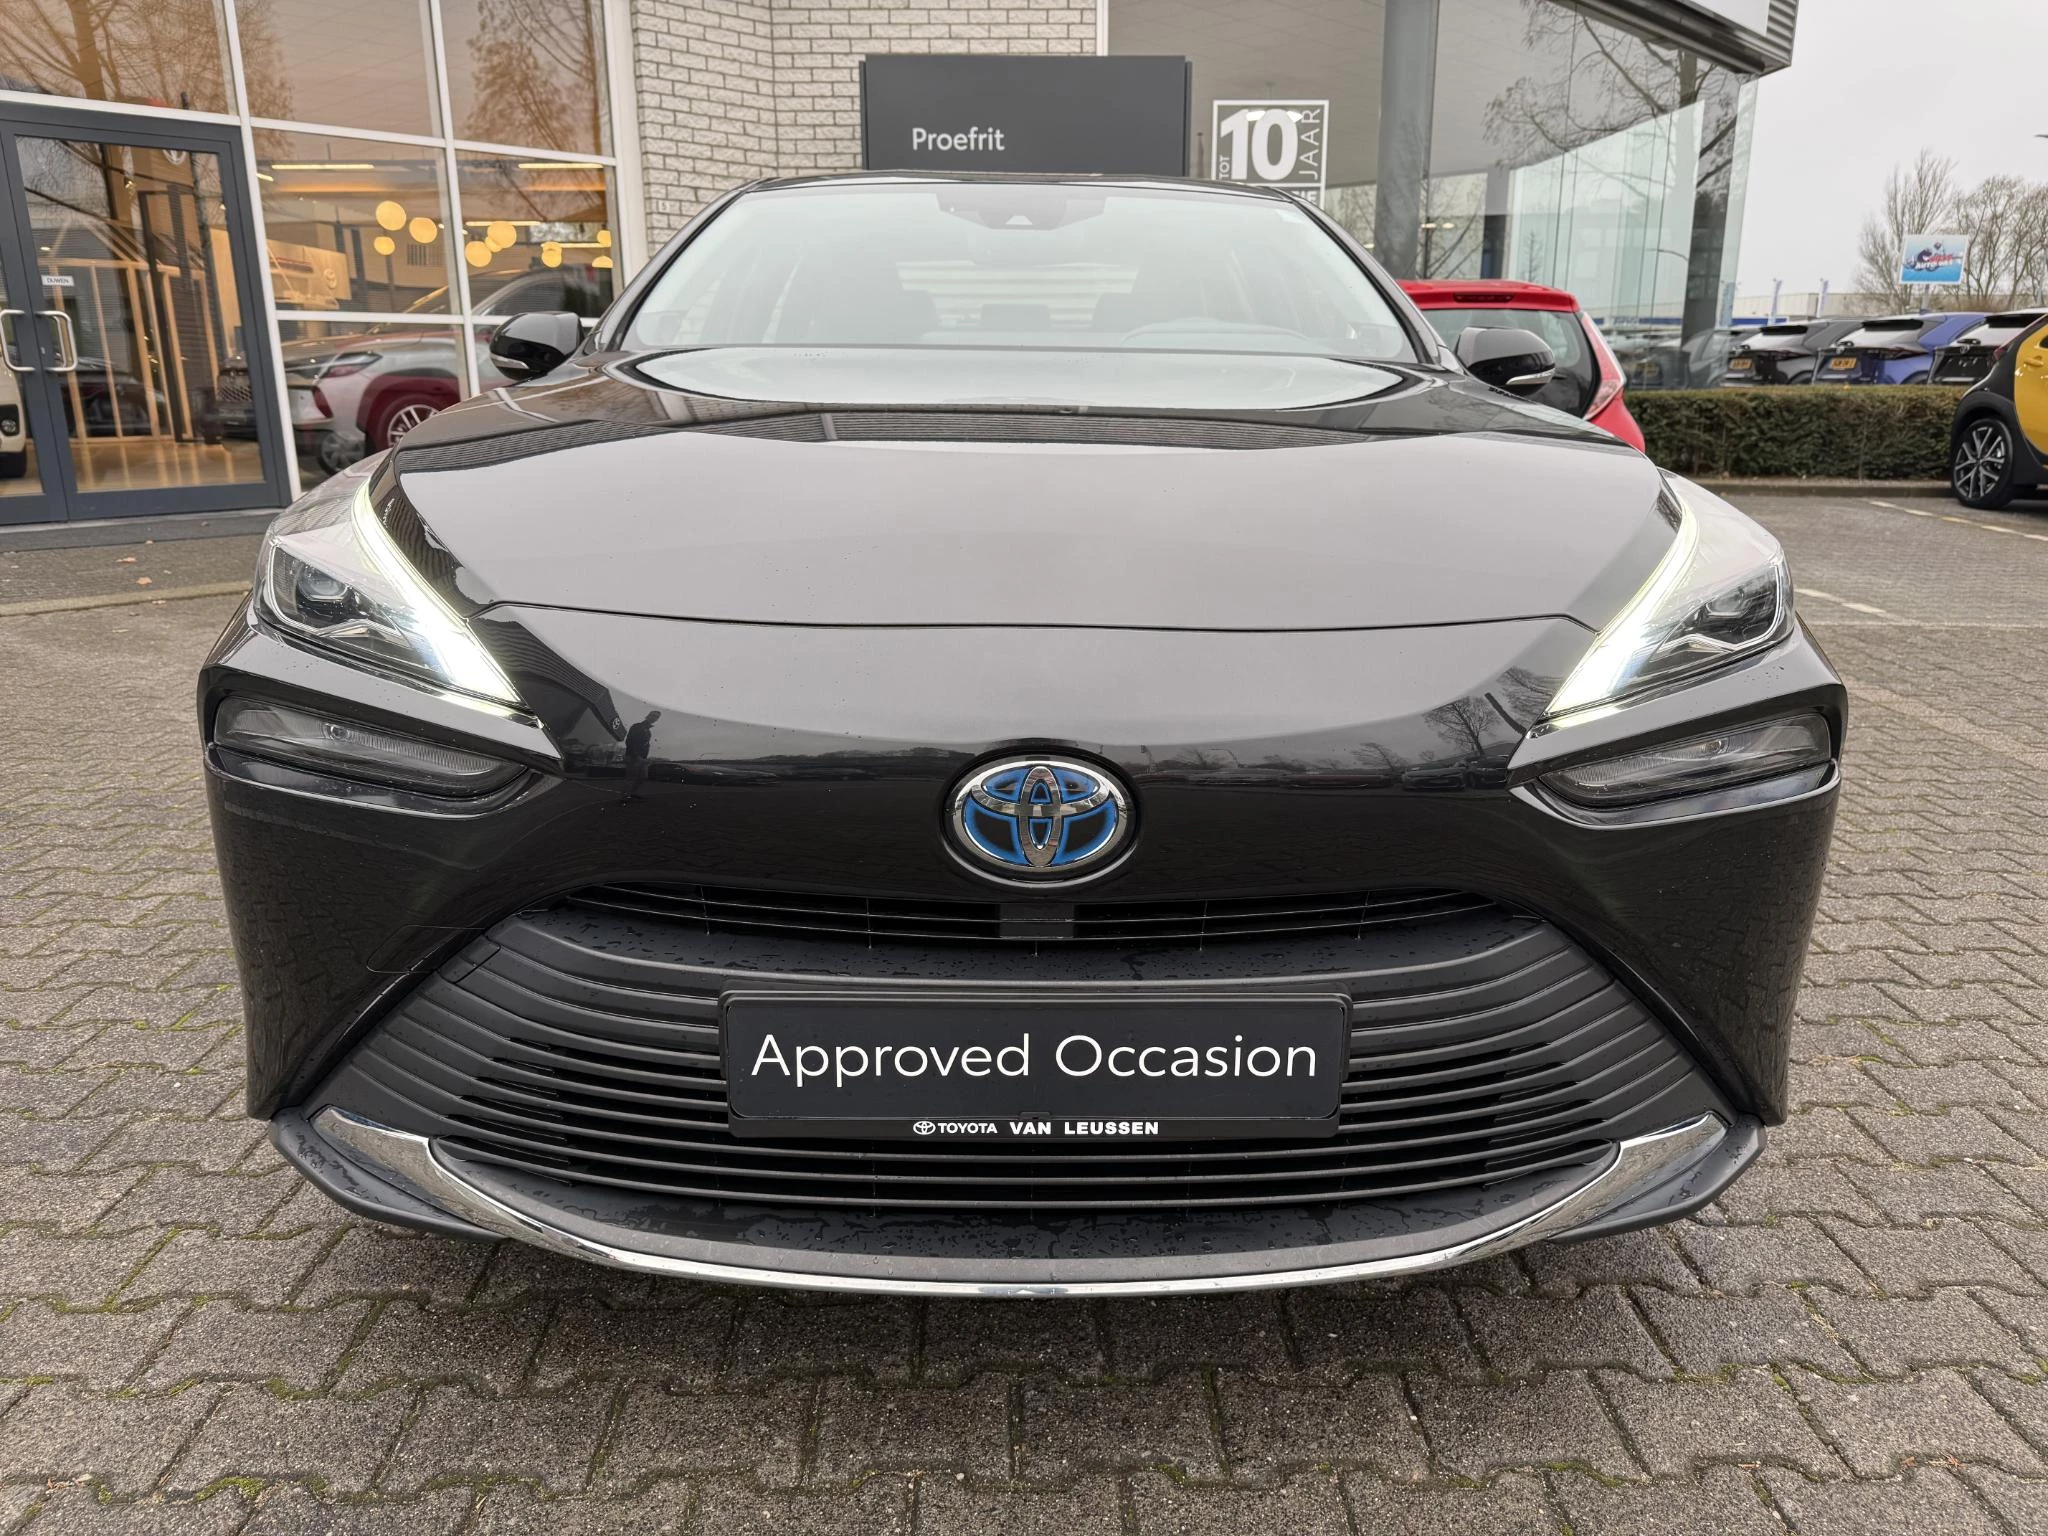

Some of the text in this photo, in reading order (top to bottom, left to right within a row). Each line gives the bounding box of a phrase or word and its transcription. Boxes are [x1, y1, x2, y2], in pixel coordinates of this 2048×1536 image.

[912, 126, 1006, 151] Proefrit
[1220, 108, 1298, 181] 10
[1299, 109, 1320, 180] JAAR
[1219, 154, 1230, 180] TOT
[751, 1032, 1316, 1088] Approved Occasion
[937, 1121, 1159, 1135] TOYOTA VAN LEUSSEN
